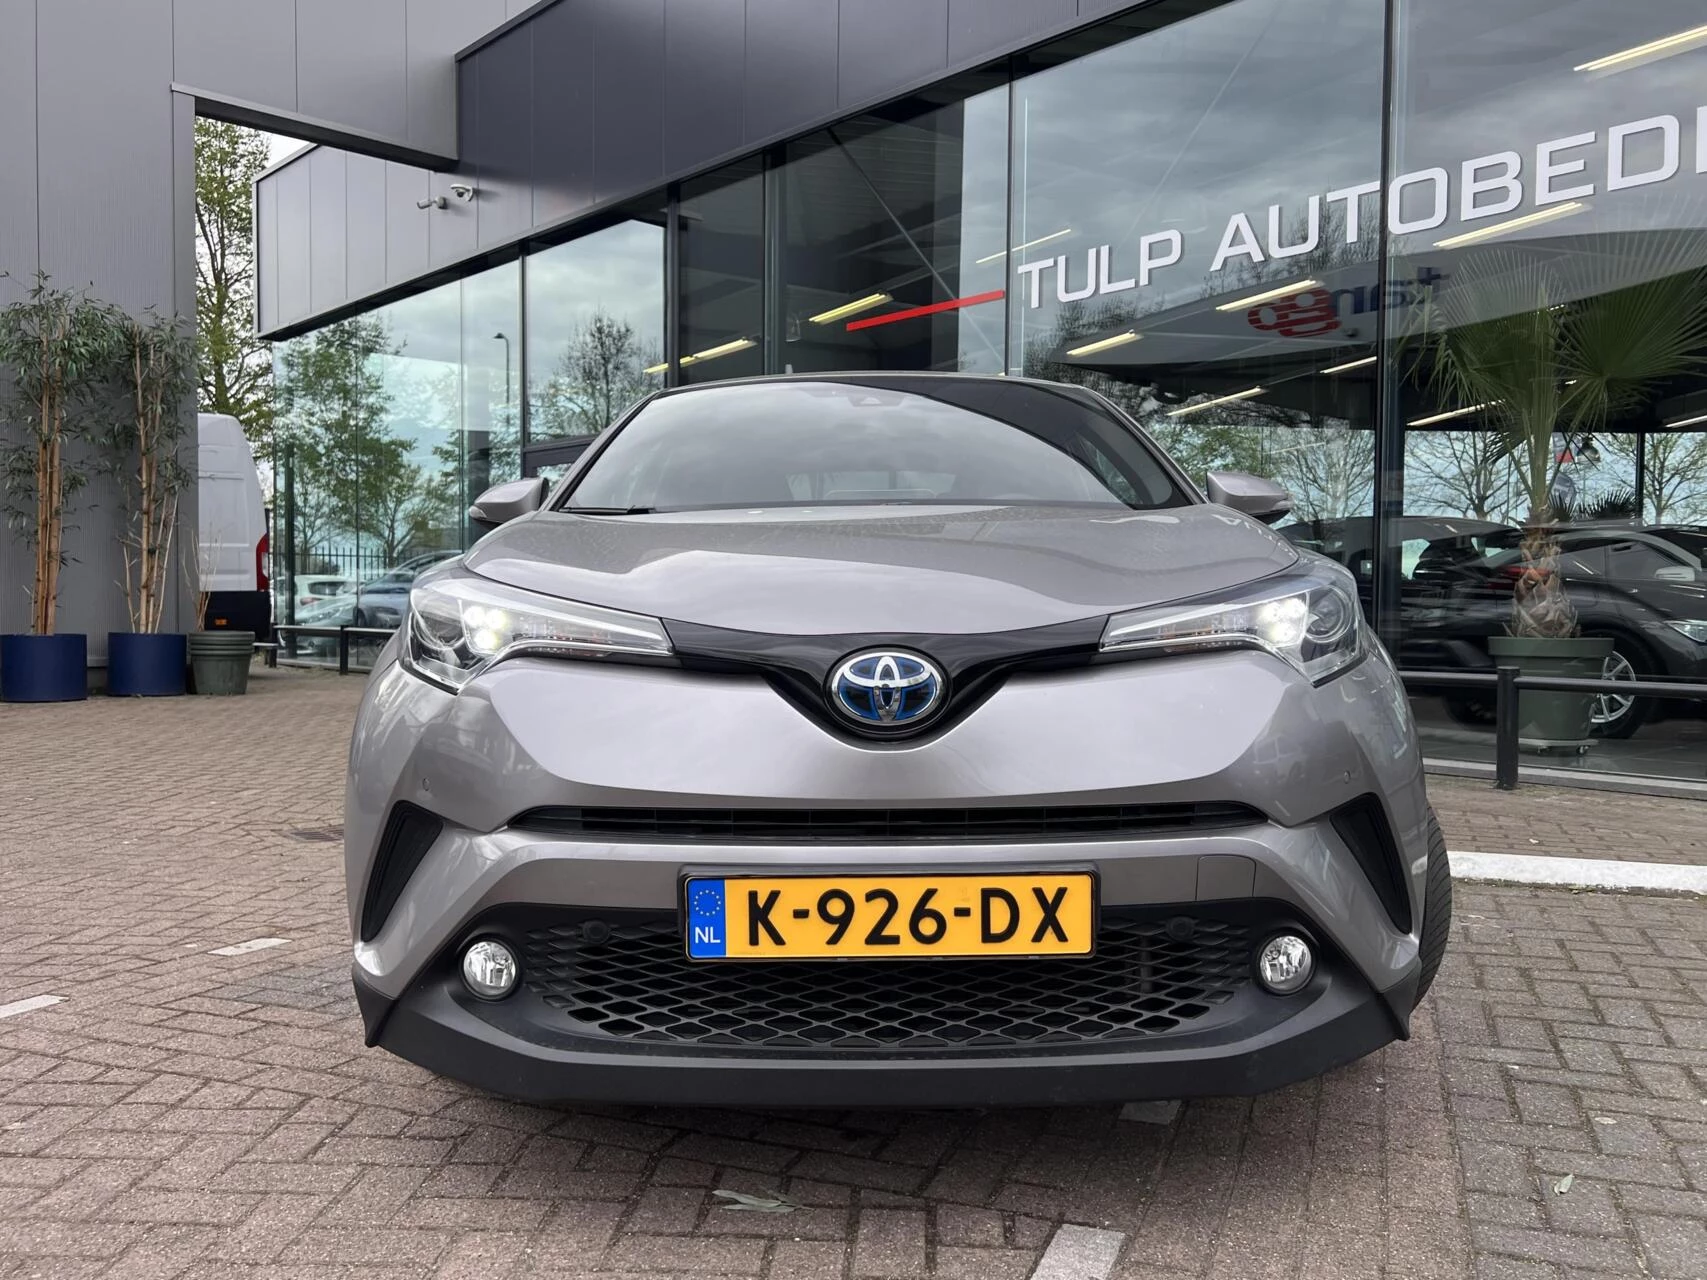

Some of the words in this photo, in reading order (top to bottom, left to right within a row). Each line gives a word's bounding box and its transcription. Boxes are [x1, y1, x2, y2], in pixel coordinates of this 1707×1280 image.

[1017, 228, 1182, 309] TULP
[1209, 105, 1707, 273] AUTOBED
[694, 926, 721, 944] NL
[748, 886, 1069, 946] K-926-DX
